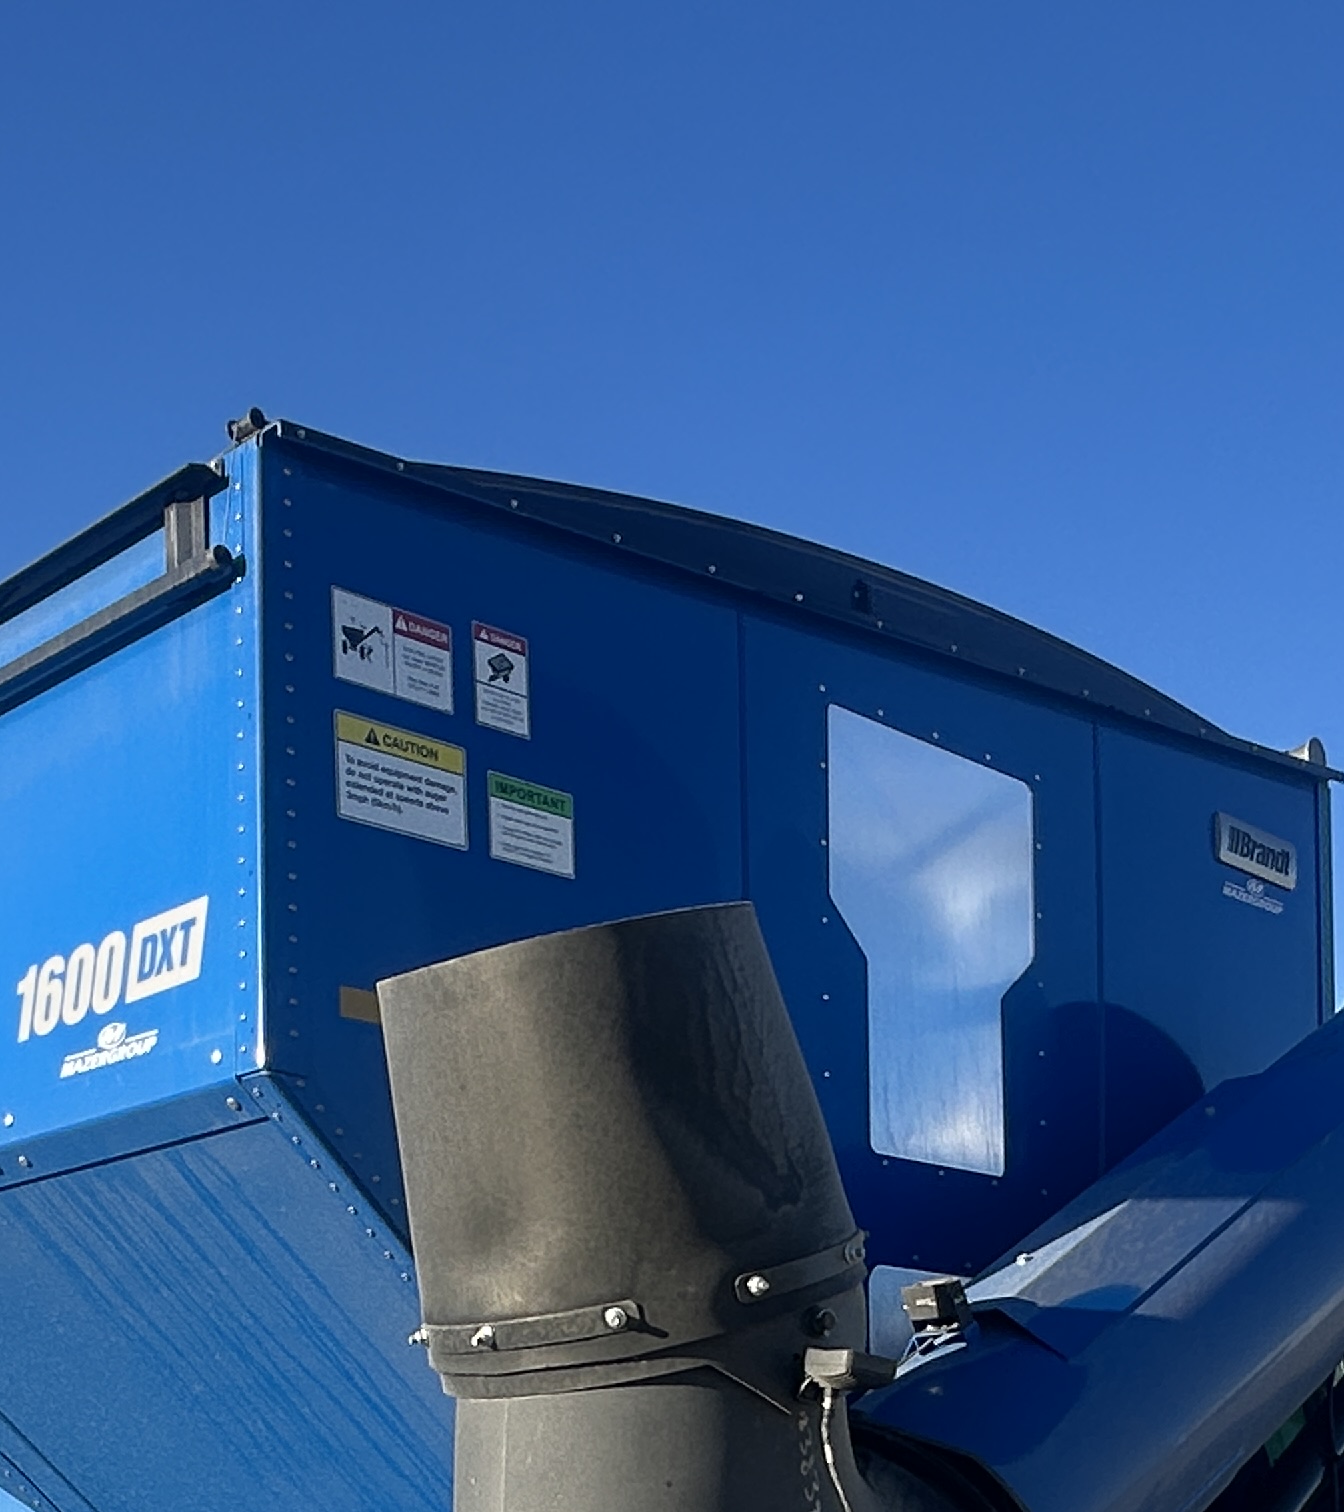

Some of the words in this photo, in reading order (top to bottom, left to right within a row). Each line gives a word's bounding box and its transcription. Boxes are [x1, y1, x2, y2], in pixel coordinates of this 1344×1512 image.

[409, 621, 448, 644] DANGER
[382, 733, 439, 761] CAUTION
[380, 766, 424, 784] equipment
[494, 780, 566, 812] IMPORTANT
[1238, 830, 1290, 876] Brandt
[16, 930, 126, 1043] 1600
[137, 916, 198, 984] DXT
